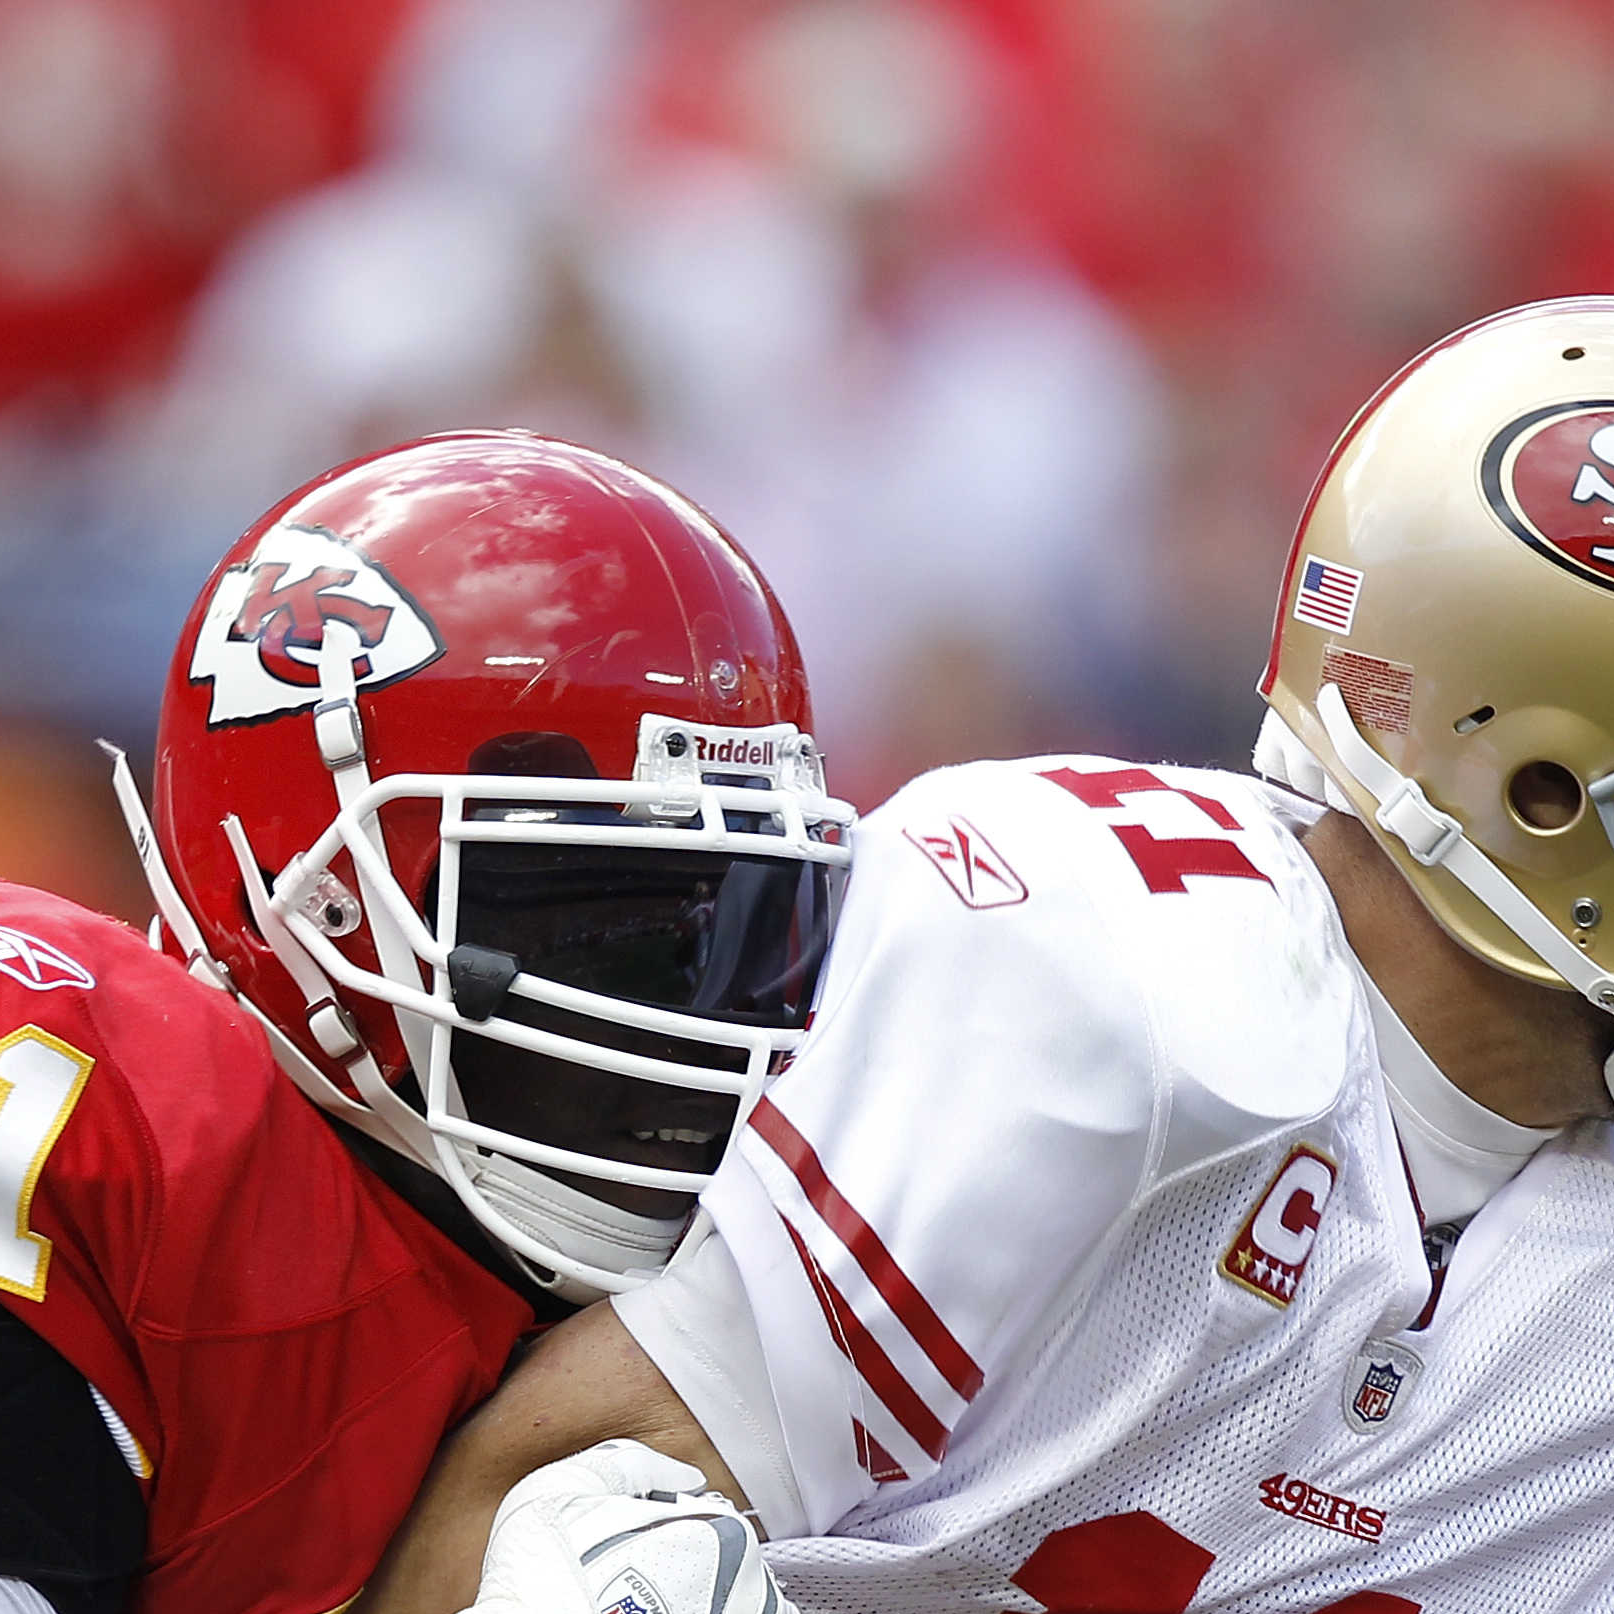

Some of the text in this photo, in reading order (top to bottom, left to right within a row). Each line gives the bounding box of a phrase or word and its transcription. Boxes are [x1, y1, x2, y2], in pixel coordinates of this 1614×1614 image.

[228, 562, 393, 689] KC
[694, 735, 774, 766] Riddell
[1252, 1155, 1333, 1266] C
[1356, 1384, 1390, 1417] NFL
[1258, 1472, 1387, 1544] 49ERS
